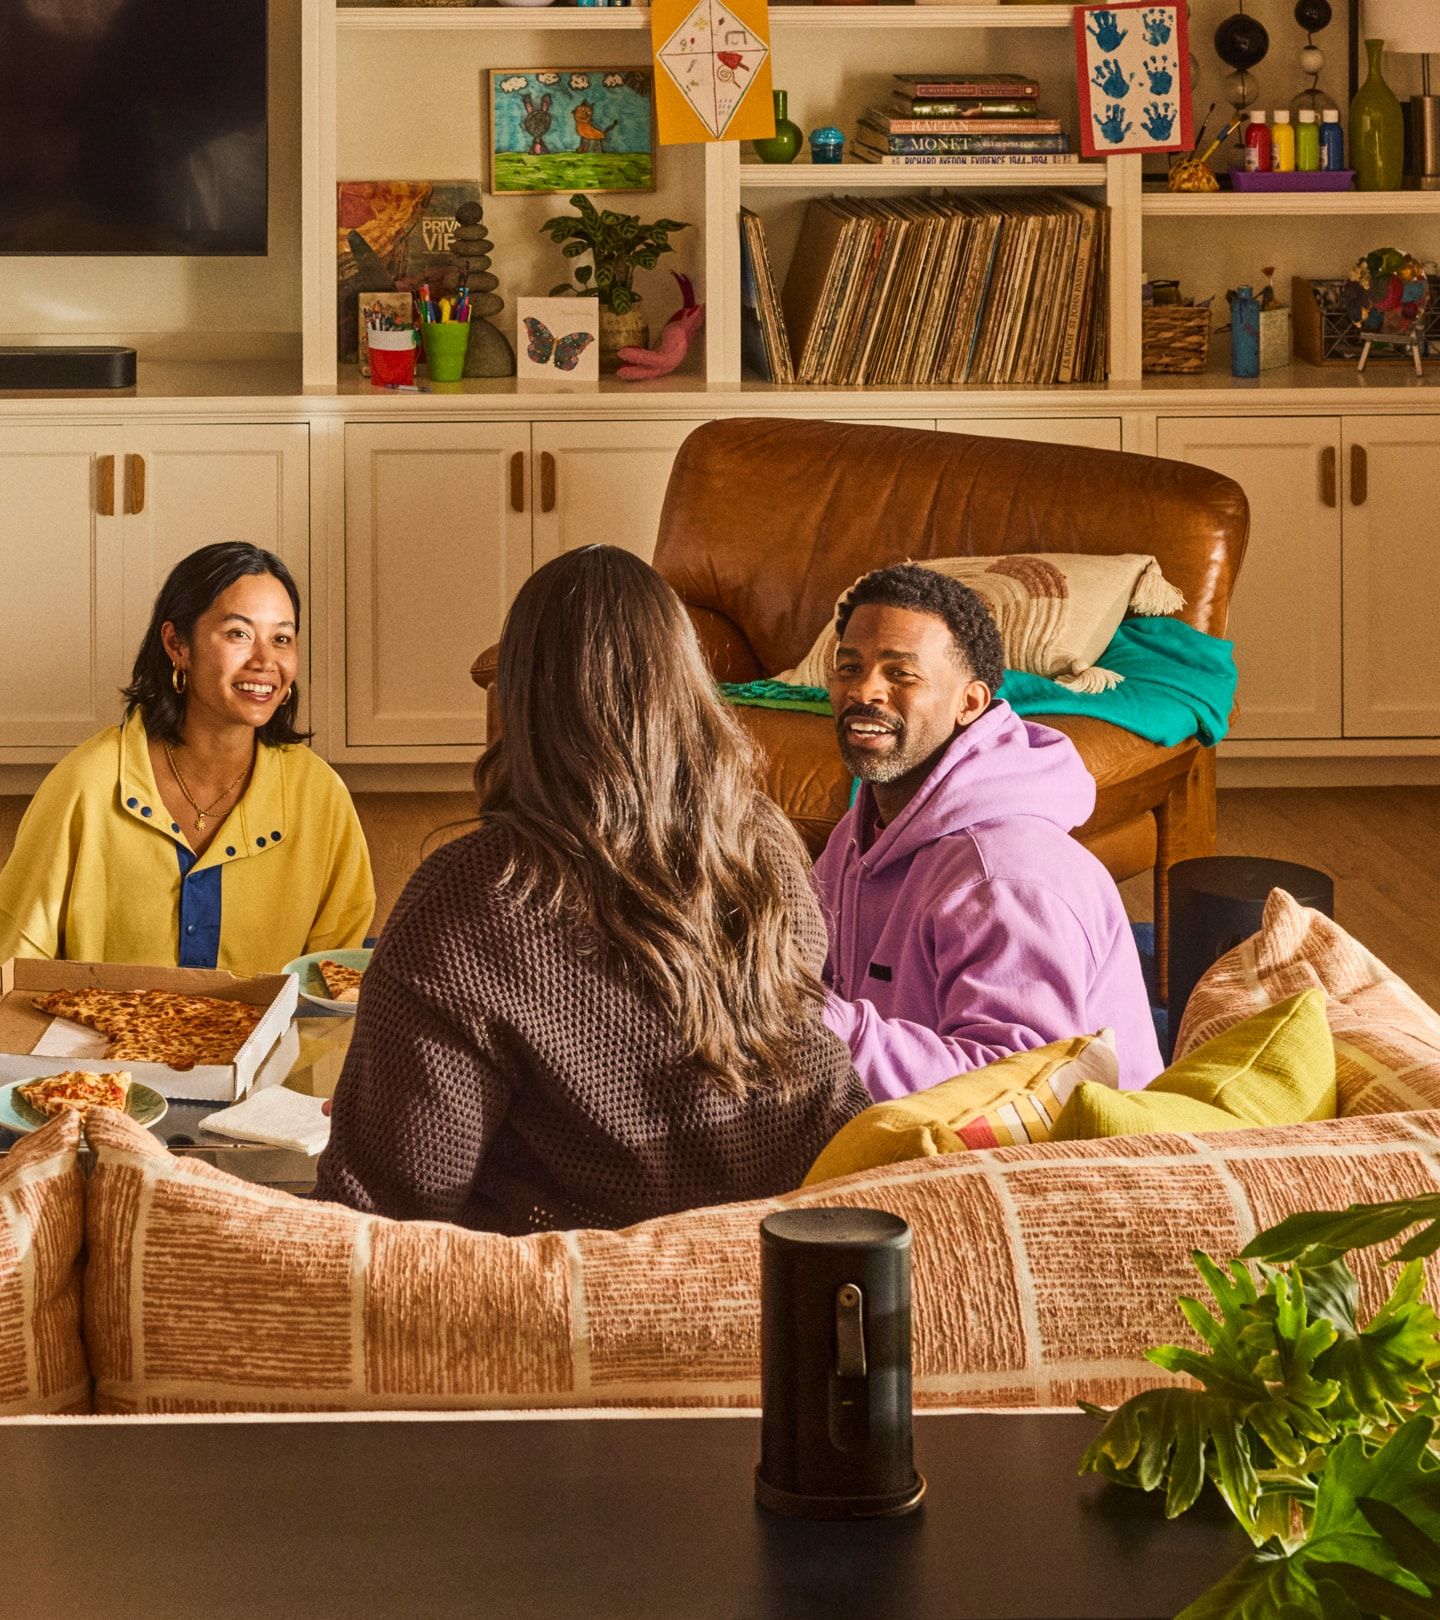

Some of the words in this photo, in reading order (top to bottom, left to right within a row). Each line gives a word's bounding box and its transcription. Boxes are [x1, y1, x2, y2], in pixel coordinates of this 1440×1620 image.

[911, 120, 969, 132] RATTAN
[910, 138, 971, 151] MONET
[905, 156, 937, 165] RICHARD
[939, 156, 967, 165] AVEDON
[970, 156, 1006, 165] EVIDENCE
[1074, 257, 1086, 293] PASSION
[1070, 293, 1081, 318] JOHN
[1064, 333, 1075, 358] BACH
